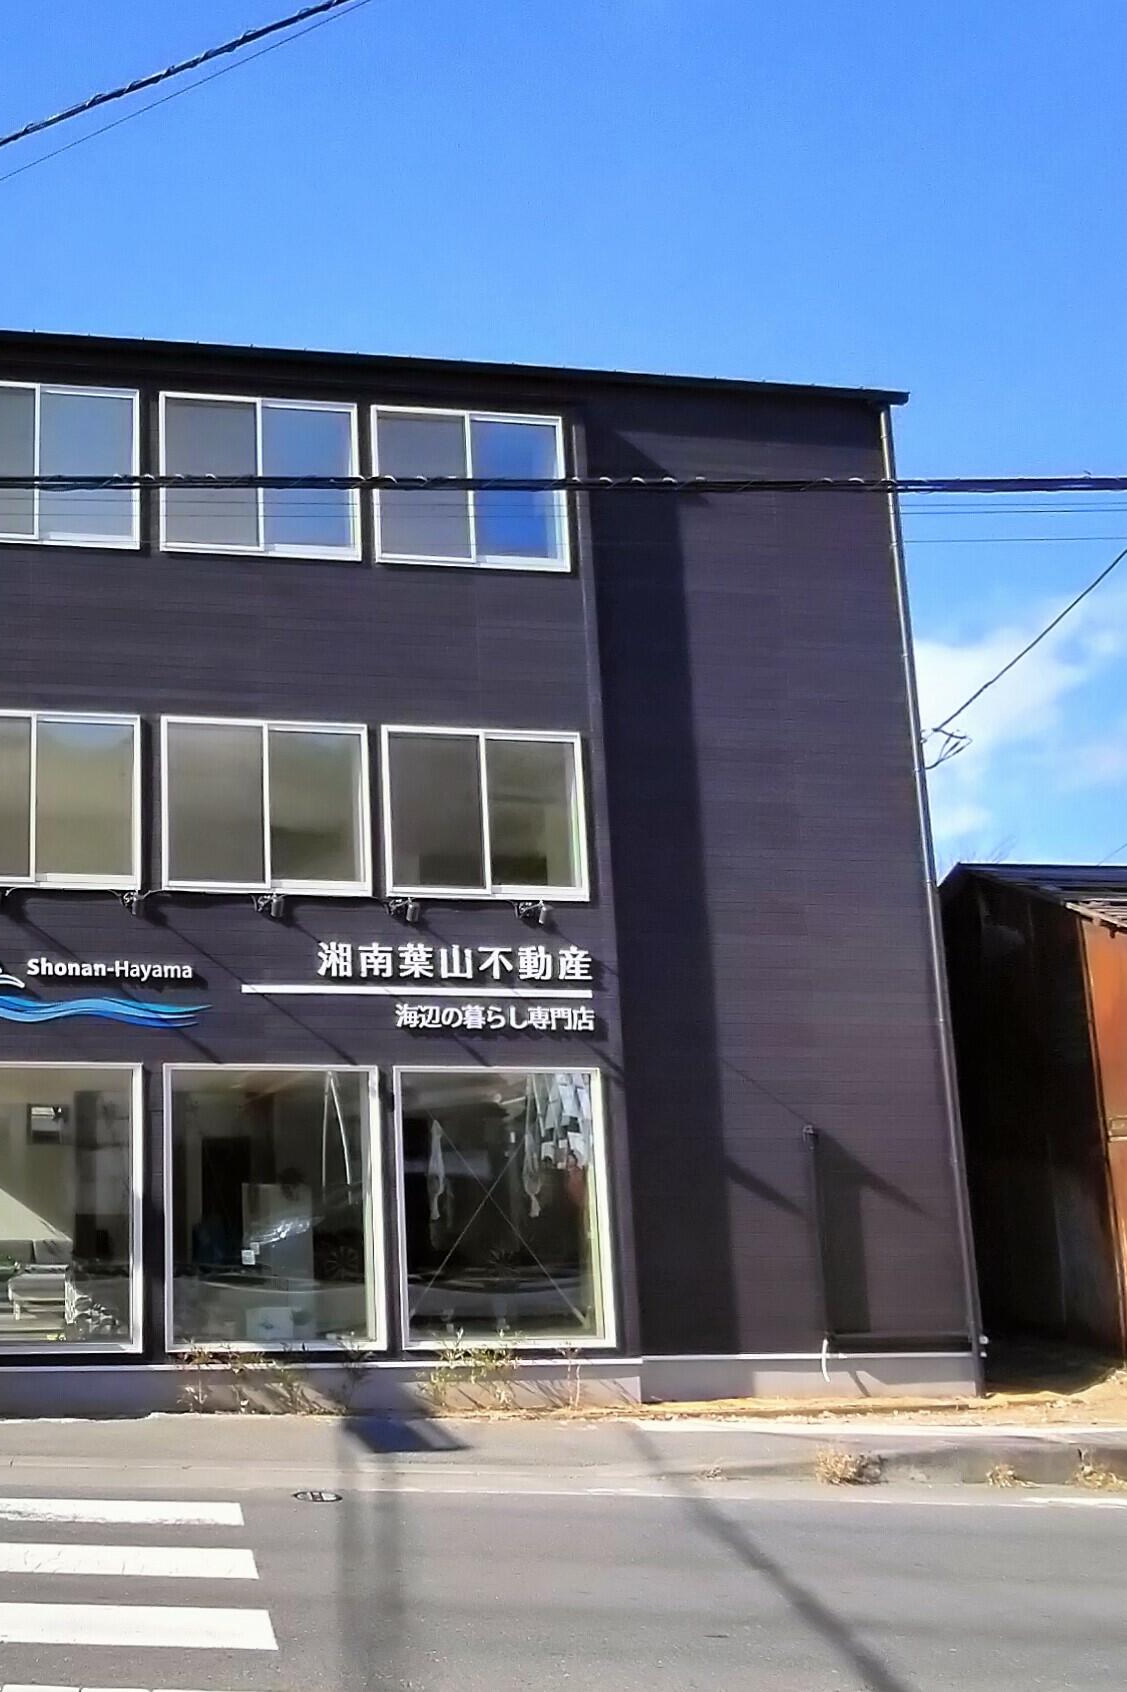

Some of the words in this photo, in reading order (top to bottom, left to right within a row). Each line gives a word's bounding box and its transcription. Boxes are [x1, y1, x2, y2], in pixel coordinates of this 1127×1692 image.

[27, 957, 193, 982] Shonan-Hayama
[317, 941, 593, 981] 湘南葉山不動産
[395, 1003, 595, 1031] 海辺の暮らし専門店
